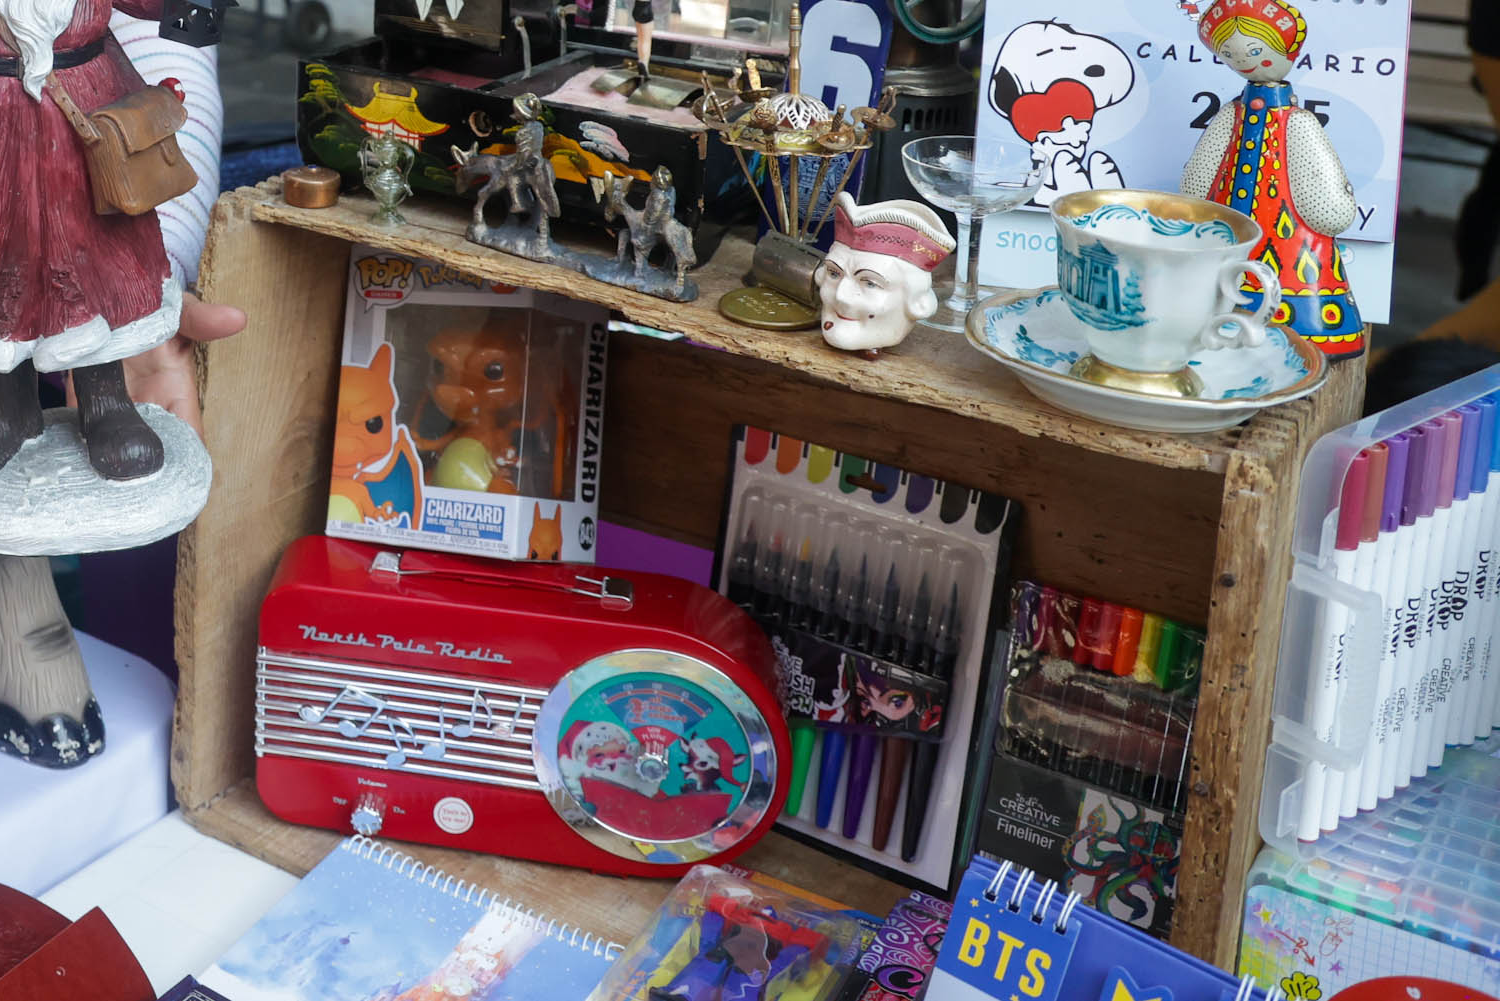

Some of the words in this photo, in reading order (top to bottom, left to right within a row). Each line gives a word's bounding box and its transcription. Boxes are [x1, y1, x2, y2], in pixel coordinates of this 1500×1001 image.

[1136, 41, 1396, 77] CALARIO
[1189, 91, 1331, 129] 25
[996, 230, 1058, 253] snoo
[355, 256, 413, 290] POP!
[581, 322, 606, 504] CHARIZARD
[426, 500, 504, 524] CHARIZARD
[1436, 581, 1455, 631] DROP
[1450, 571, 1470, 621] DROP
[298, 625, 376, 648] North
[377, 634, 434, 655] Pole
[436, 641, 513, 665] Radio
[1403, 598, 1421, 649] DROP
[1436, 657, 1452, 703] CREATIVE
[1462, 636, 1476, 682] CREATIVE
[1392, 687, 1407, 733] CREATIVE
[1424, 668, 1439, 713] CREATIVE
[996, 818, 1056, 850] Fineliner
[1000, 798, 1061, 827] CREATIVE
[957, 916, 1052, 998] BTS
